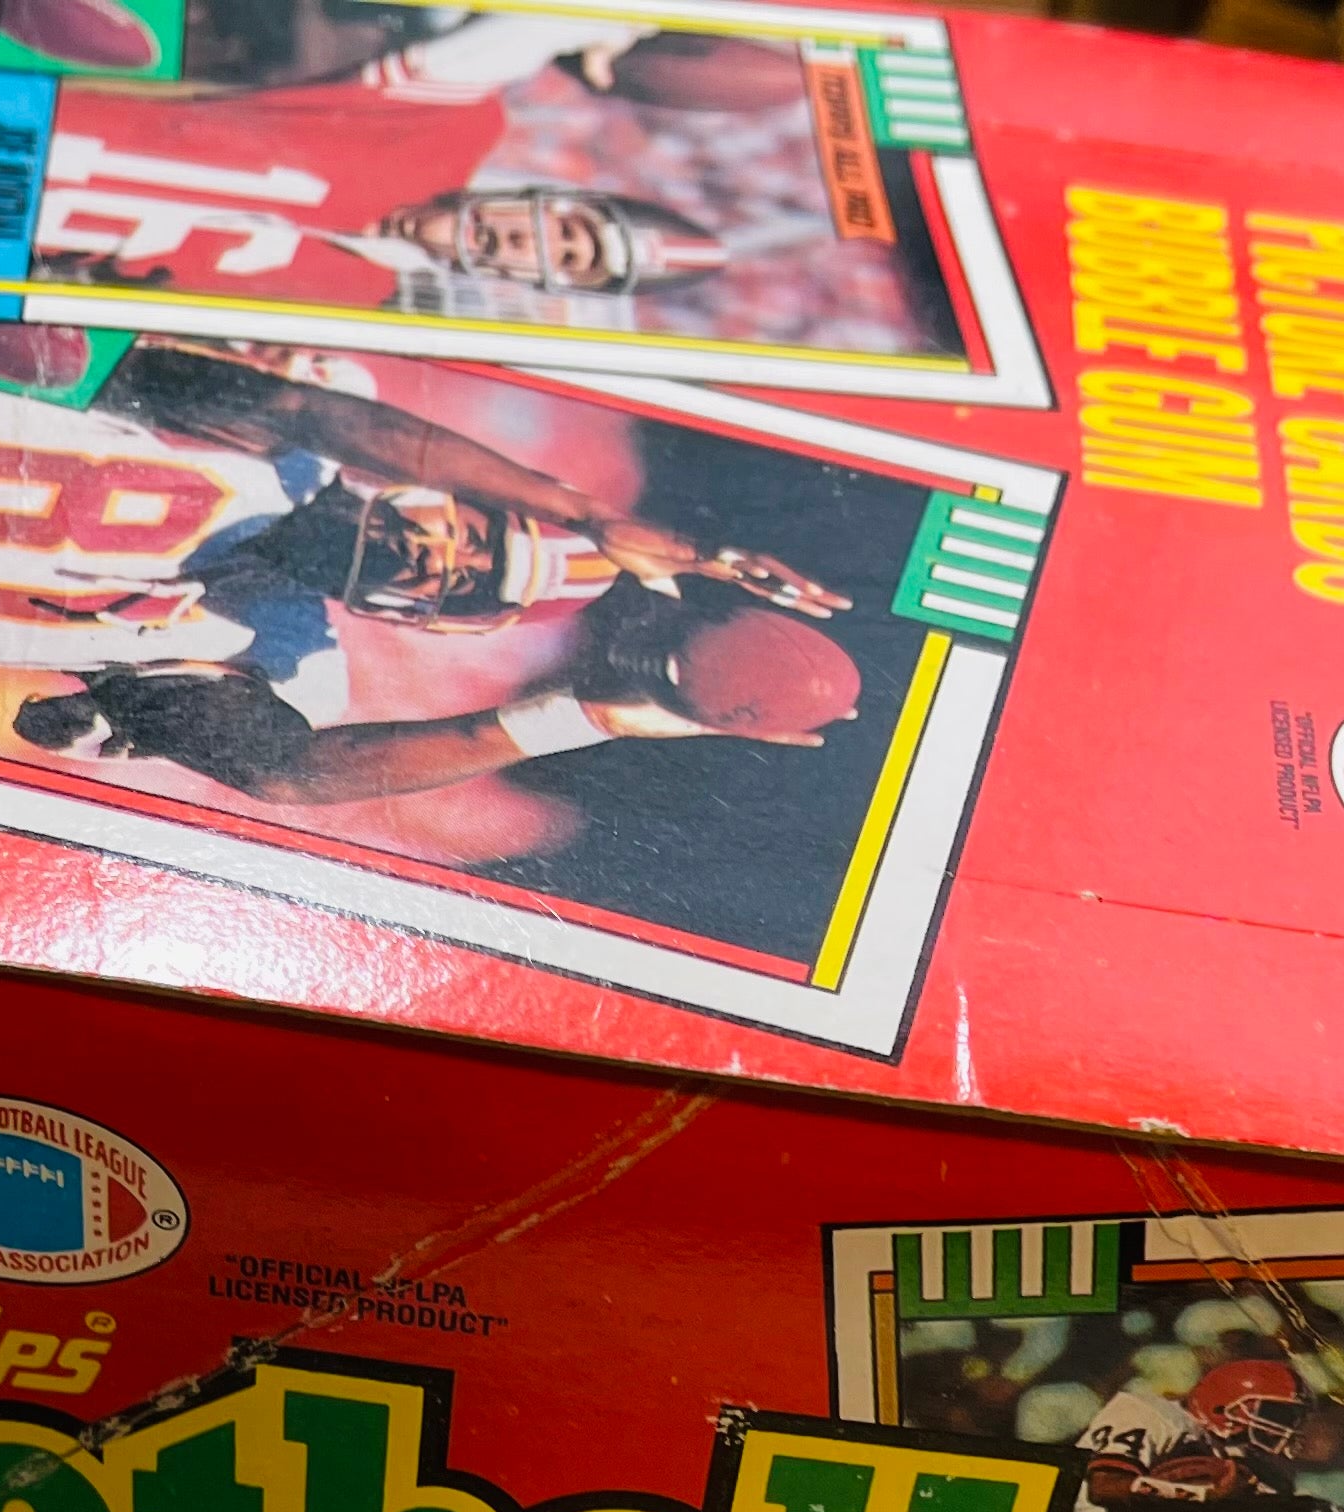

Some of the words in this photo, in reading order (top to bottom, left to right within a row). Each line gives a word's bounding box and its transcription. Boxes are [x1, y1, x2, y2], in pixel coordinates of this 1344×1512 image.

[1065, 184, 1248, 374] BUBBLE
[1077, 370, 1264, 509] GUM
[1270, 700, 1294, 760] LICENSED
[1301, 774, 1323, 815] NFLPA
[74, 1127, 149, 1200] LEAGUE
[208, 1275, 348, 1314] LICENSED
[374, 1278, 469, 1308] NFLPA
